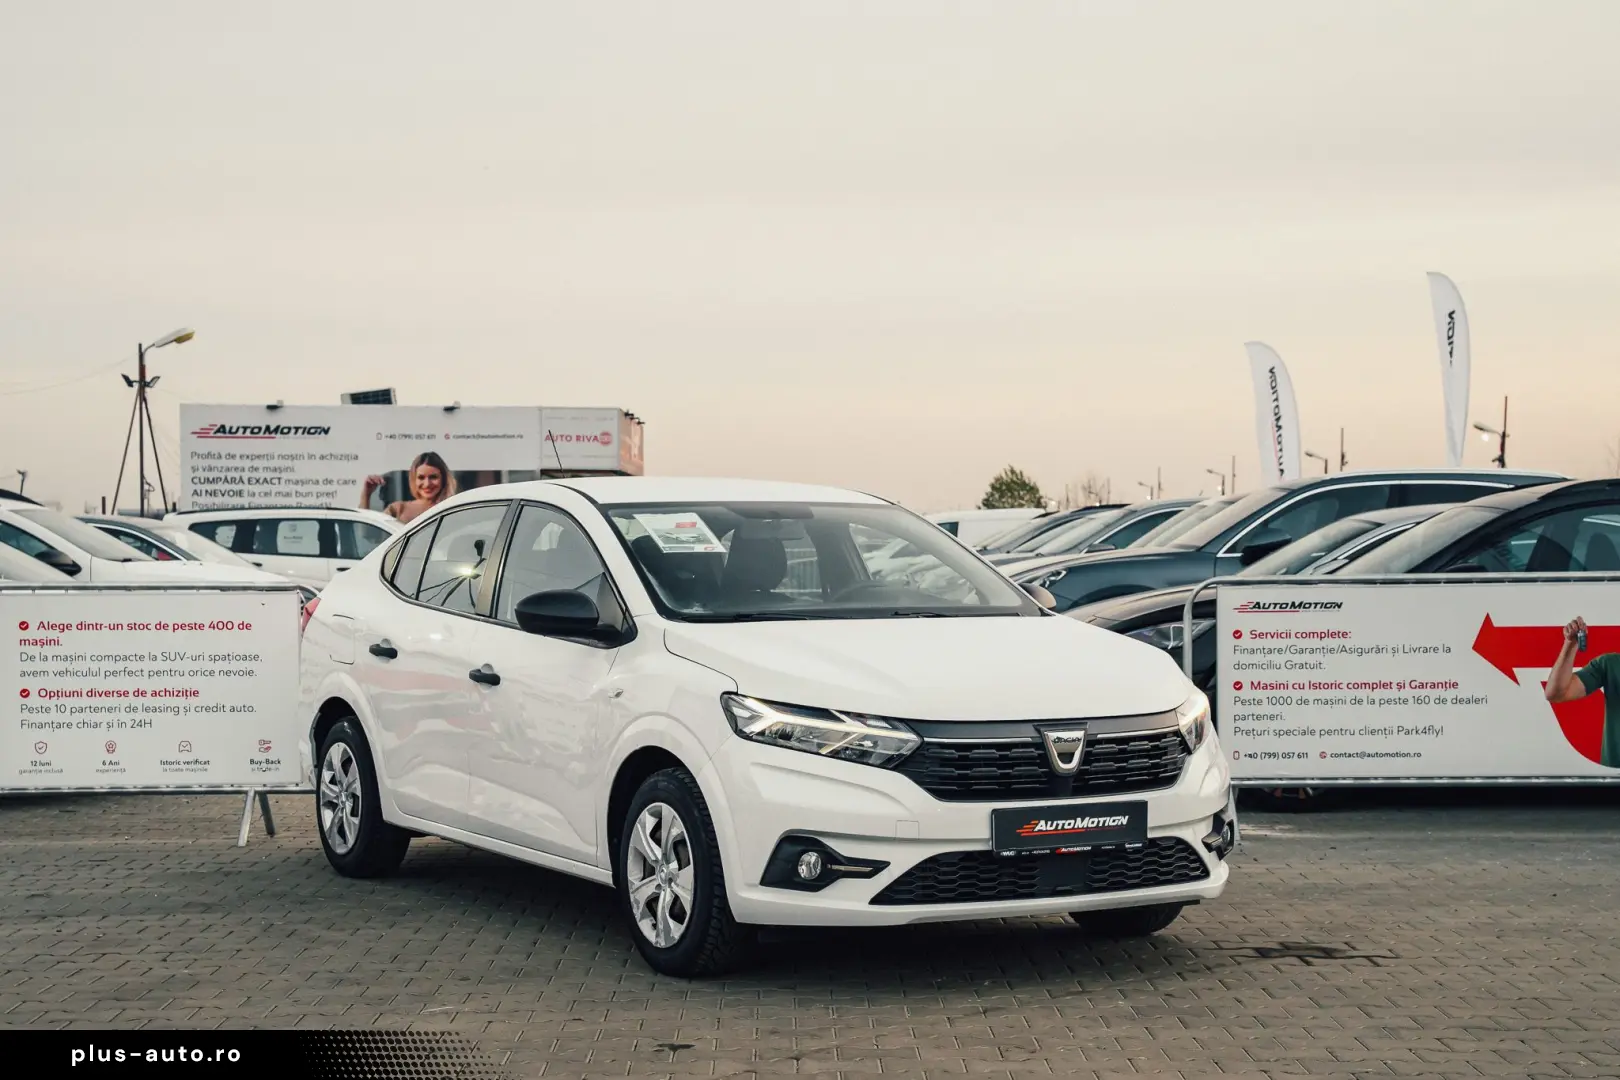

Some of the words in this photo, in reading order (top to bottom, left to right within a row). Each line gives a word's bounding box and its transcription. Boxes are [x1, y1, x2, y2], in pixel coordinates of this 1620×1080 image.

[213, 424, 331, 435] AUTOMOTION
[544, 434, 572, 442] AUTO
[576, 434, 599, 442] RIVA
[191, 451, 222, 461] Profită
[225, 452, 237, 460] de
[239, 452, 275, 462] experții
[277, 452, 304, 462] noștri
[319, 452, 359, 462] achiziția
[191, 465, 199, 473] și
[201, 464, 245, 473] vânzarea
[248, 464, 260, 473] de
[191, 475, 245, 485] CUMPĂRĂ
[248, 477, 282, 485] EXACT
[285, 477, 320, 486] mașina
[322, 478, 334, 486] de
[191, 489, 203, 498] AI
[204, 489, 245, 498] NEVOIE
[247, 489, 256, 498] la
[258, 489, 272, 498] cel
[274, 489, 293, 498] mai
[295, 489, 313, 498] bun
[1249, 601, 1343, 610] AUTOMOTION
[37, 620, 72, 633] Alege
[76, 620, 124, 631] dintr-un
[127, 622, 152, 631] stoc
[154, 620, 169, 631] de
[172, 621, 205, 633] peste
[208, 620, 234, 631] 400
[237, 620, 252, 631] de
[1249, 629, 1291, 640] Servicii
[1294, 629, 1351, 641] complete:
[19, 636, 62, 649] mașini.
[1391, 644, 1400, 657] și
[1402, 644, 1439, 655] Livrare
[1442, 643, 1451, 654] la
[20, 652, 35, 662] De
[39, 651, 48, 662] la
[51, 652, 87, 665] mașini
[90, 653, 145, 665] compacte
[148, 651, 158, 662] la
[160, 651, 205, 662] SUV-uri
[208, 652, 263, 665] spațioase,
[1233, 659, 1281, 670] domiciliu
[1284, 659, 1326, 670] Gratuit.
[20, 669, 49, 678] avem
[52, 666, 101, 678] vehiculul
[104, 666, 145, 680] perfect
[148, 668, 185, 680] pentru
[188, 667, 215, 677] orice
[219, 667, 257, 677] nevoie.
[1250, 680, 1289, 691] Masini
[1292, 683, 1305, 691] cu
[1308, 680, 1344, 691] Istoric
[1346, 680, 1393, 693] complet
[1396, 680, 1406, 693] și
[1409, 679, 1459, 693] Garanție
[38, 688, 83, 700] Opțiuni
[86, 687, 129, 698] diverse
[132, 687, 147, 698] de
[150, 687, 200, 700] achiziție
[1234, 695, 1263, 706] Peste
[1266, 695, 1293, 706] 1000
[1296, 695, 1310, 706] de
[1313, 694, 1347, 709] mașini
[1350, 694, 1364, 706] de
[1366, 694, 1376, 706] la
[1378, 695, 1409, 708] peste
[1412, 695, 1431, 705] 160
[1434, 694, 1447, 705] de
[1451, 694, 1488, 705] dealeri
[20, 704, 51, 714] Peste
[54, 704, 66, 714] 10
[70, 704, 121, 717] parteneri
[124, 703, 139, 714] de
[142, 703, 180, 717] leasing
[183, 704, 192, 716] și
[194, 703, 226, 714] credit
[229, 704, 257, 714] auto.
[1233, 711, 1286, 724] parteneri.
[20, 720, 73, 732] Finanțare
[76, 719, 103, 730] chiar
[106, 719, 115, 732] și
[117, 719, 127, 729] în
[130, 719, 152, 729] 24H
[1234, 726, 1270, 739] Prețuri
[1273, 725, 1316, 738] speciale
[1319, 726, 1356, 738] pentru
[1358, 725, 1394, 739] clienții
[1397, 725, 1444, 738] Park4fly!
[1260, 751, 1279, 760] (799)
[1330, 751, 1422, 759] contact@automotion.ro
[1033, 815, 1129, 832] AUTOMOTION
